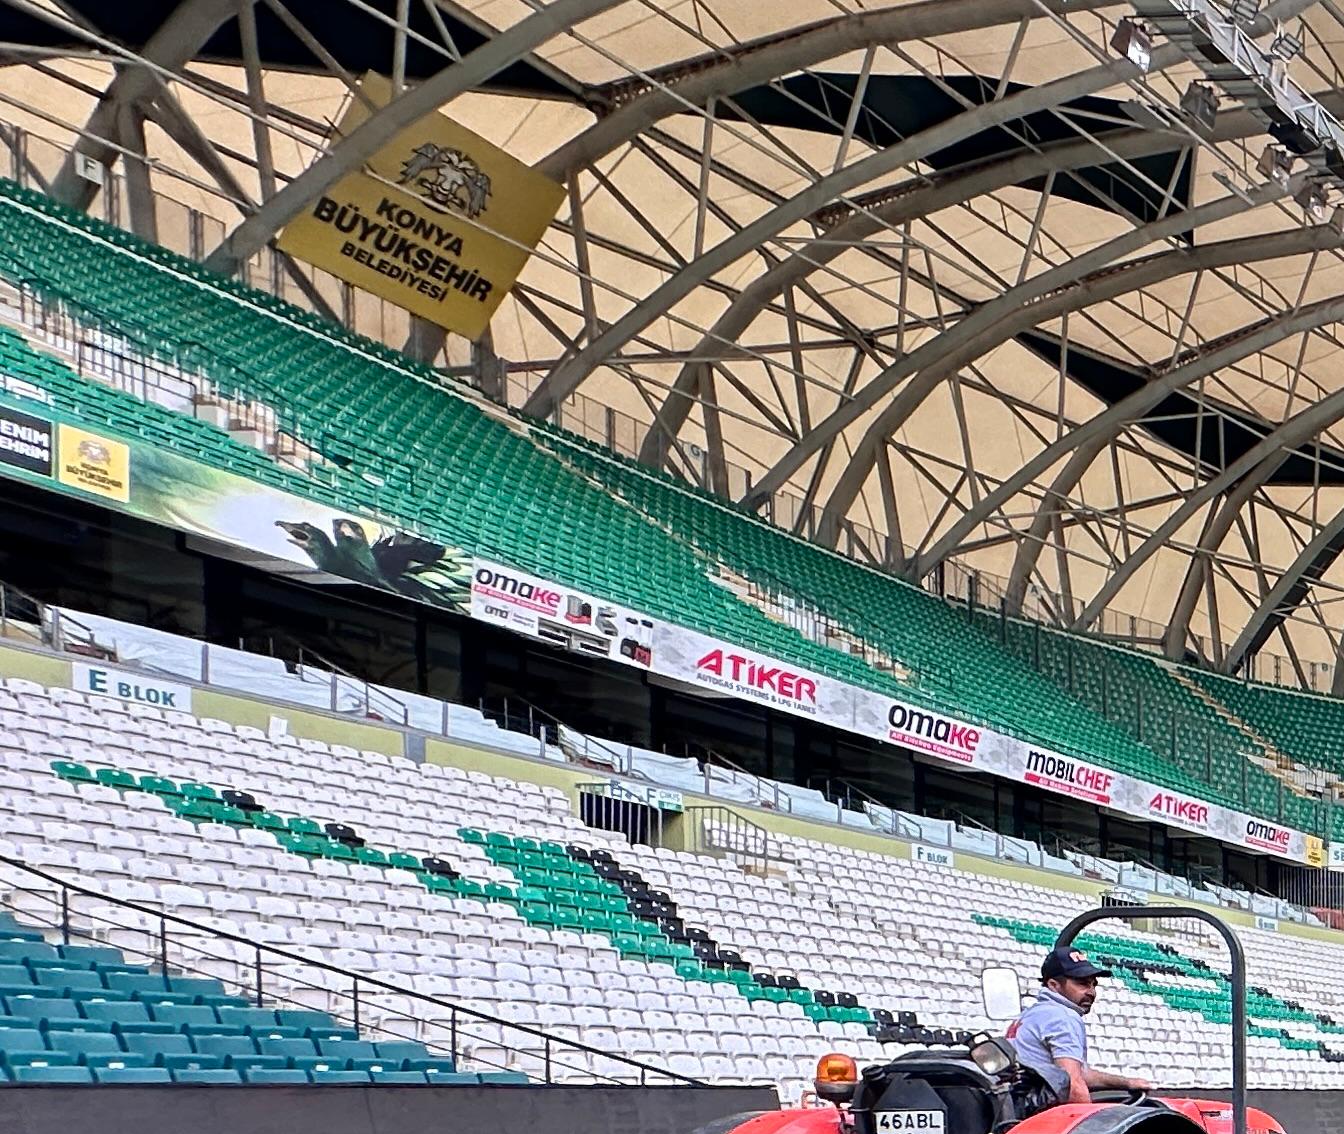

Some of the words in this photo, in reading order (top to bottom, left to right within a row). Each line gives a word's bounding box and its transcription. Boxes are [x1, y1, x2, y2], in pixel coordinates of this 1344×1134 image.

[376, 197, 463, 257] KONYA
[313, 196, 493, 302] BÜYÜKŞEHİR
[340, 241, 449, 303] BELEDİYESİ
[89, 669, 107, 693] E
[117, 682, 176, 708] BLOK
[696, 672, 734, 690] AUTOGAS
[917, 846, 924, 860] F
[927, 853, 948, 865] BLOK
[880, 1113, 941, 1129] 46ABL
